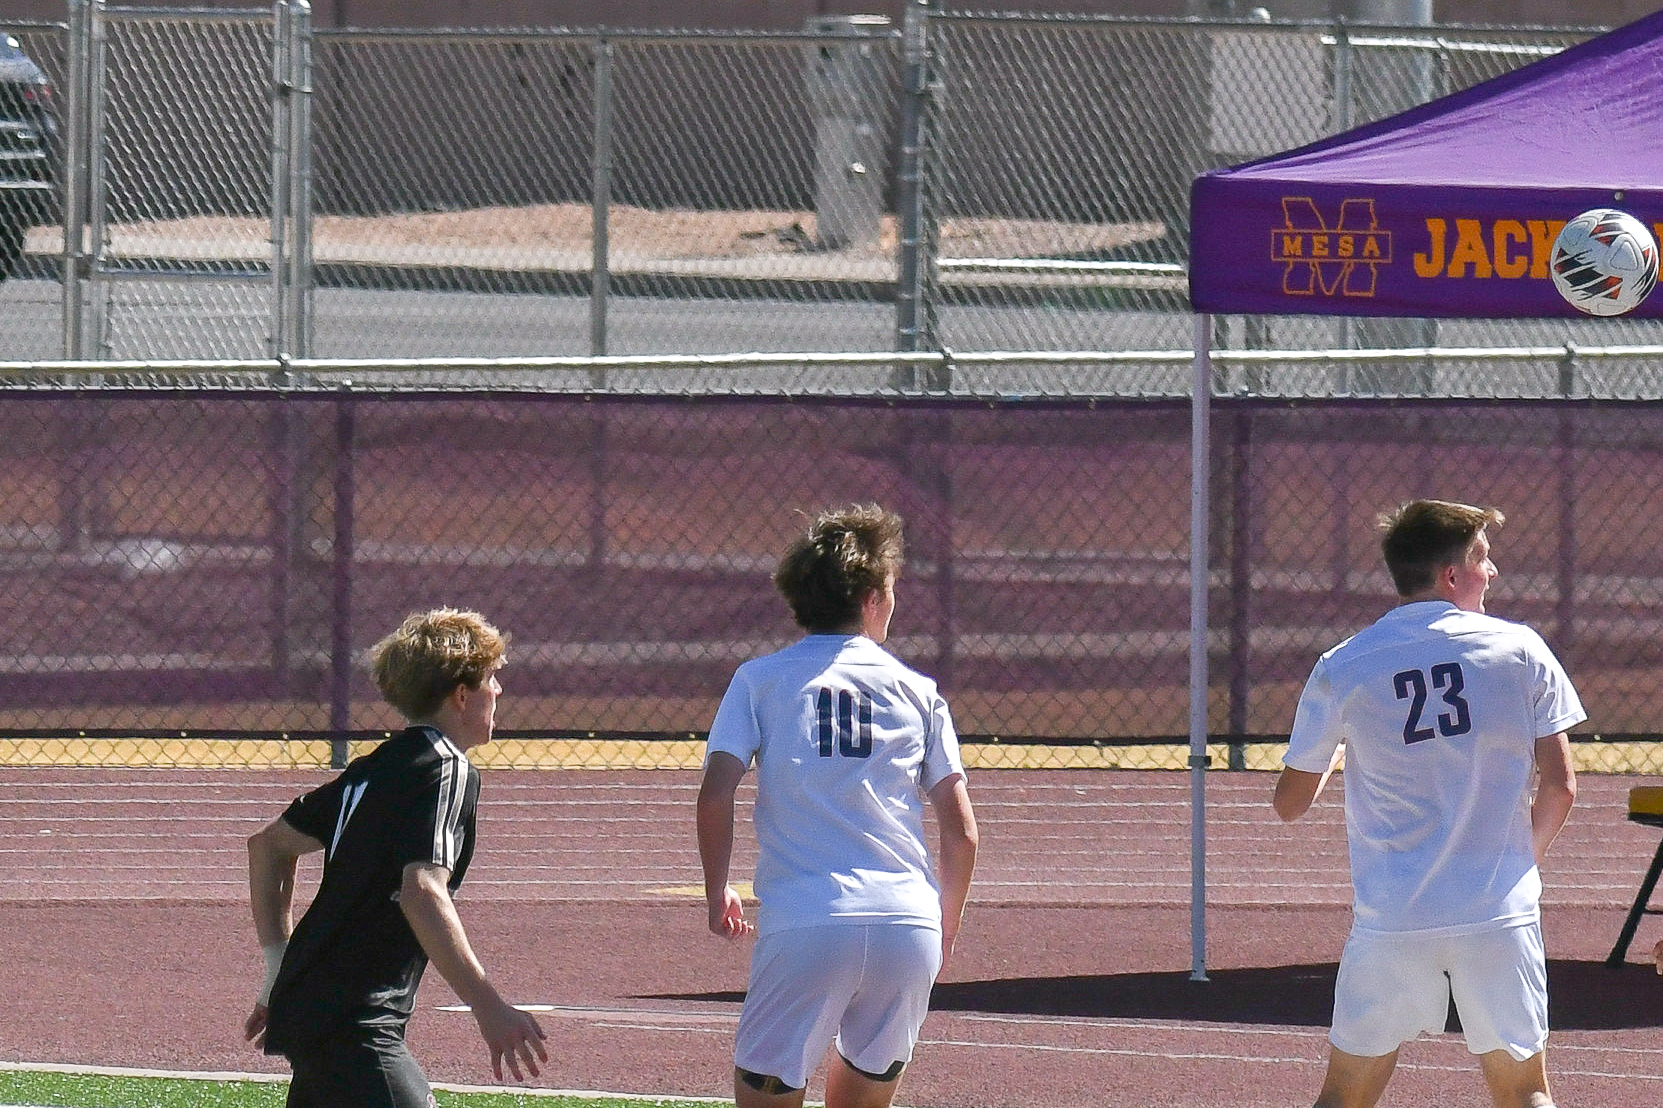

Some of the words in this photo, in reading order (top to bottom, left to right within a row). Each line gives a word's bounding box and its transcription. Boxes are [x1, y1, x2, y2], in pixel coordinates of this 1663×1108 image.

[1283, 235, 1381, 257] MESA
[816, 686, 873, 759] 10
[1392, 661, 1472, 746] 23
